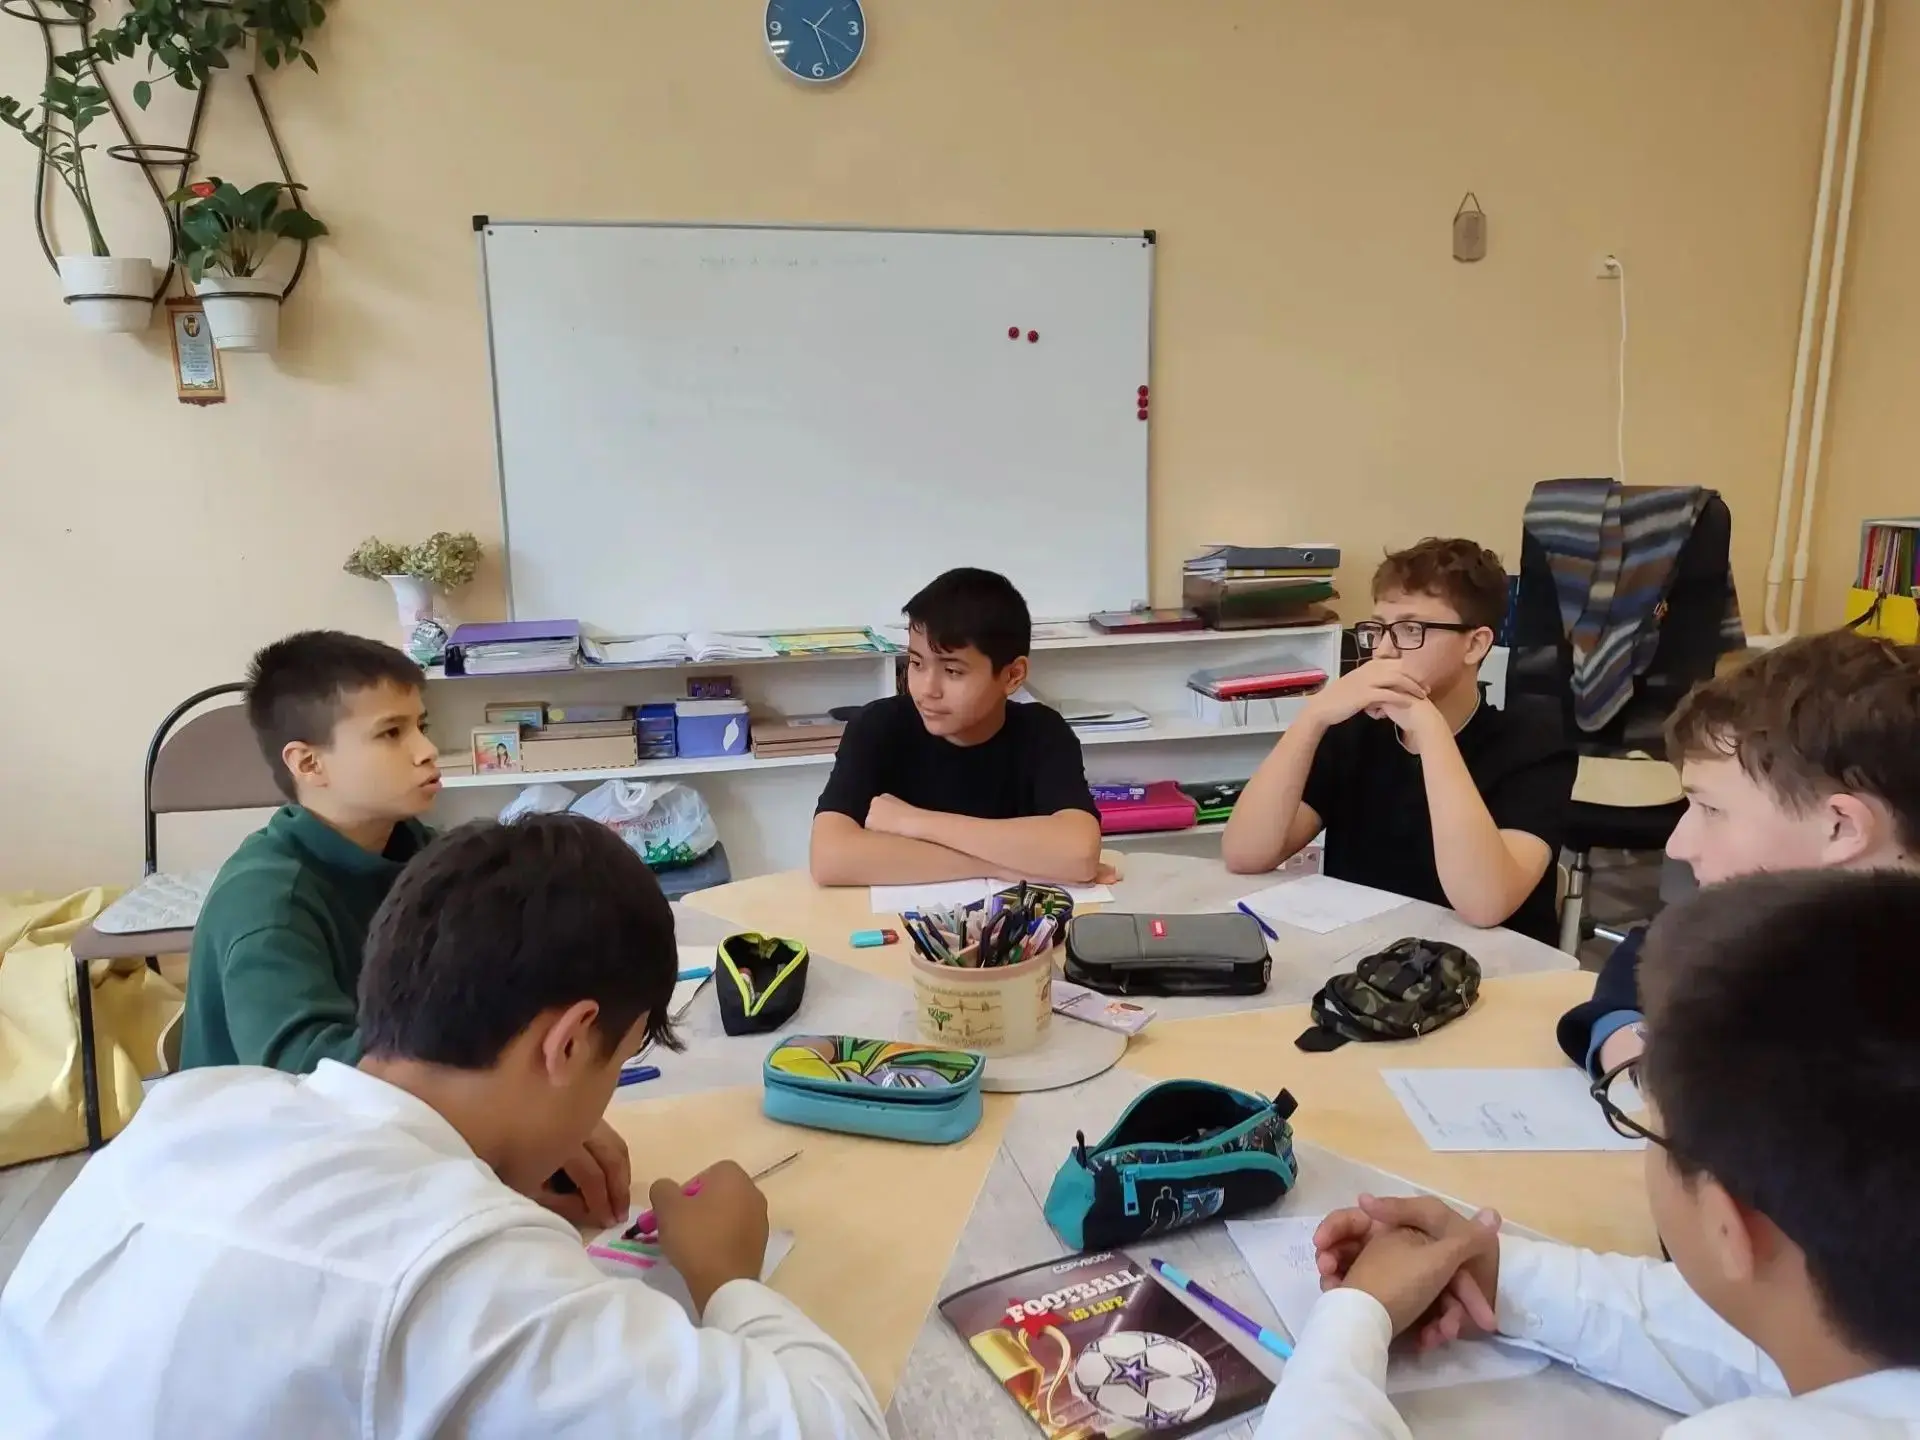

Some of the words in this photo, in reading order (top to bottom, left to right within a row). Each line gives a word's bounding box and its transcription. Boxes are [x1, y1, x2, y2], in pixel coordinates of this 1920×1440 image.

[769, 20, 782, 35] 9
[847, 20, 860, 35] 3
[811, 62, 825, 77] 6
[1006, 1269, 1145, 1323] FOOTBALL
[1089, 1295, 1127, 1315] LIFE
